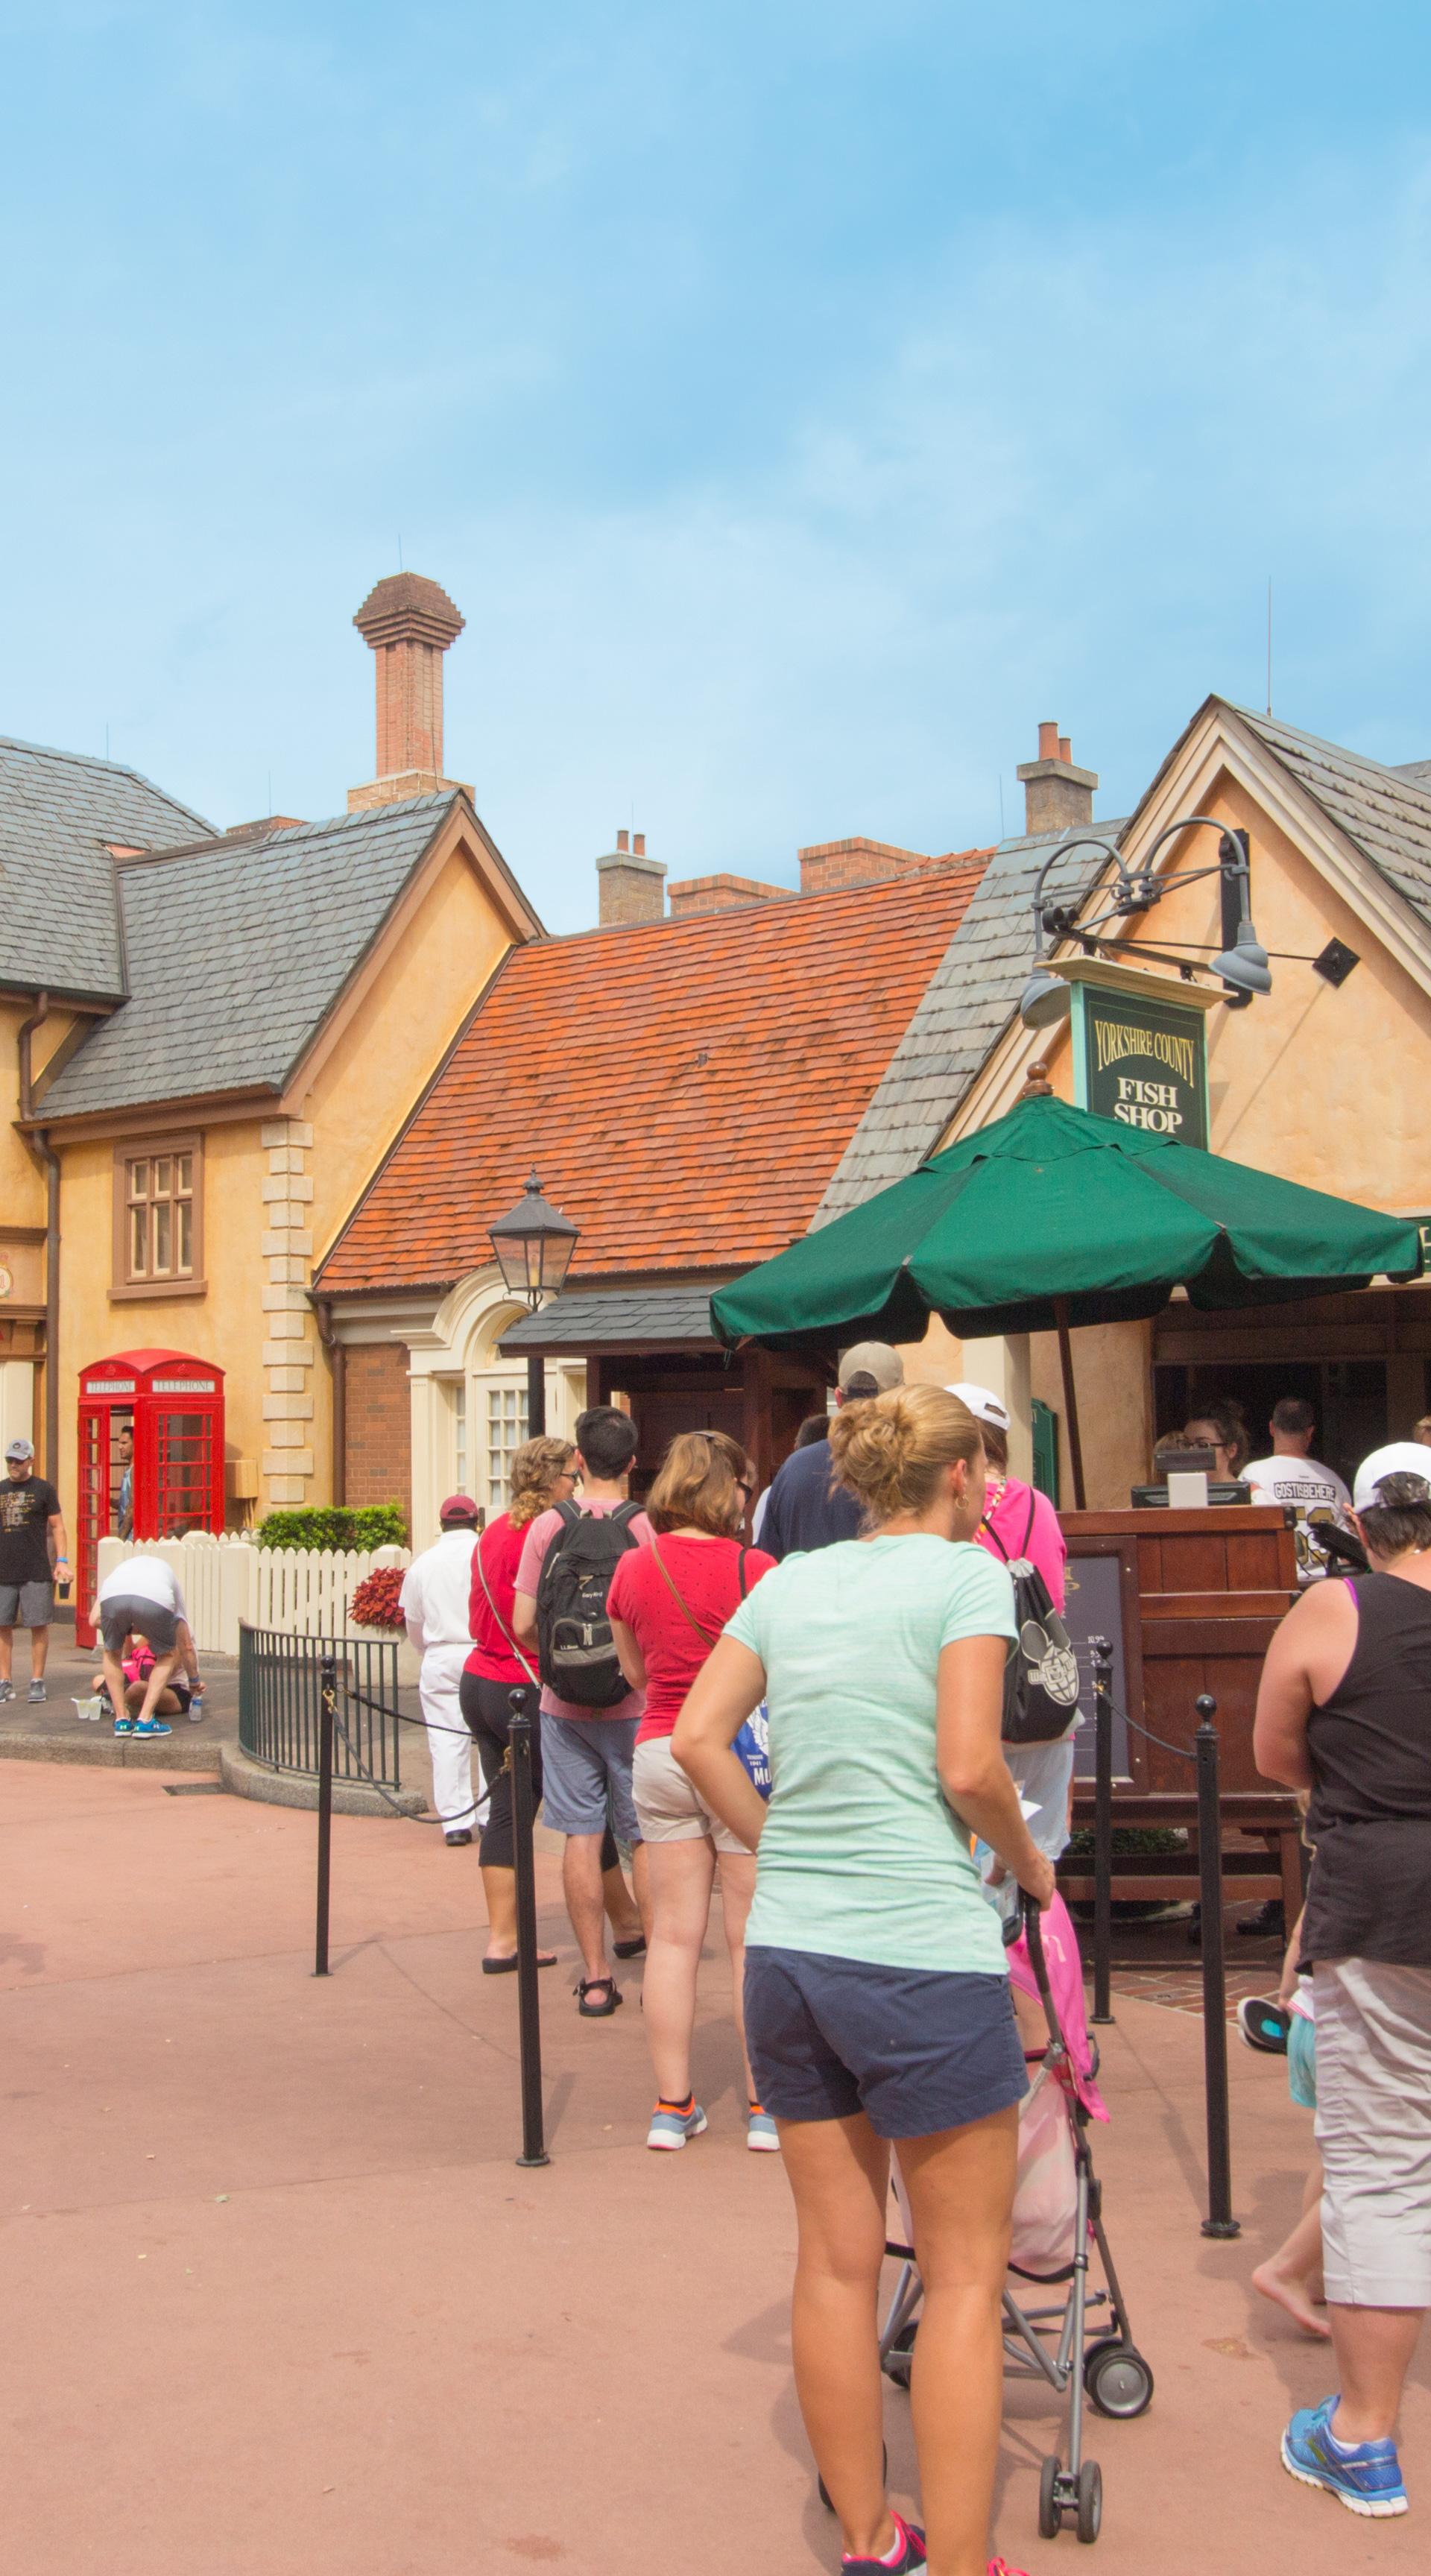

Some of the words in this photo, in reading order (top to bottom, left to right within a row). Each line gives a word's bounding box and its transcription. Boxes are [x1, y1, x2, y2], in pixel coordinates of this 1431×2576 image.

[1095, 1020, 1154, 1071] YORKSHIRE
[1154, 1032, 1194, 1088] COUNTY
[1117, 1077, 1178, 1108] FISH
[1114, 1103, 1183, 1134] SHOP
[90, 1382, 133, 1392] TELEPHONE
[157, 1380, 210, 1391] TELEPHONE
[1274, 1482, 1336, 1502] GOSTISBEHERE
